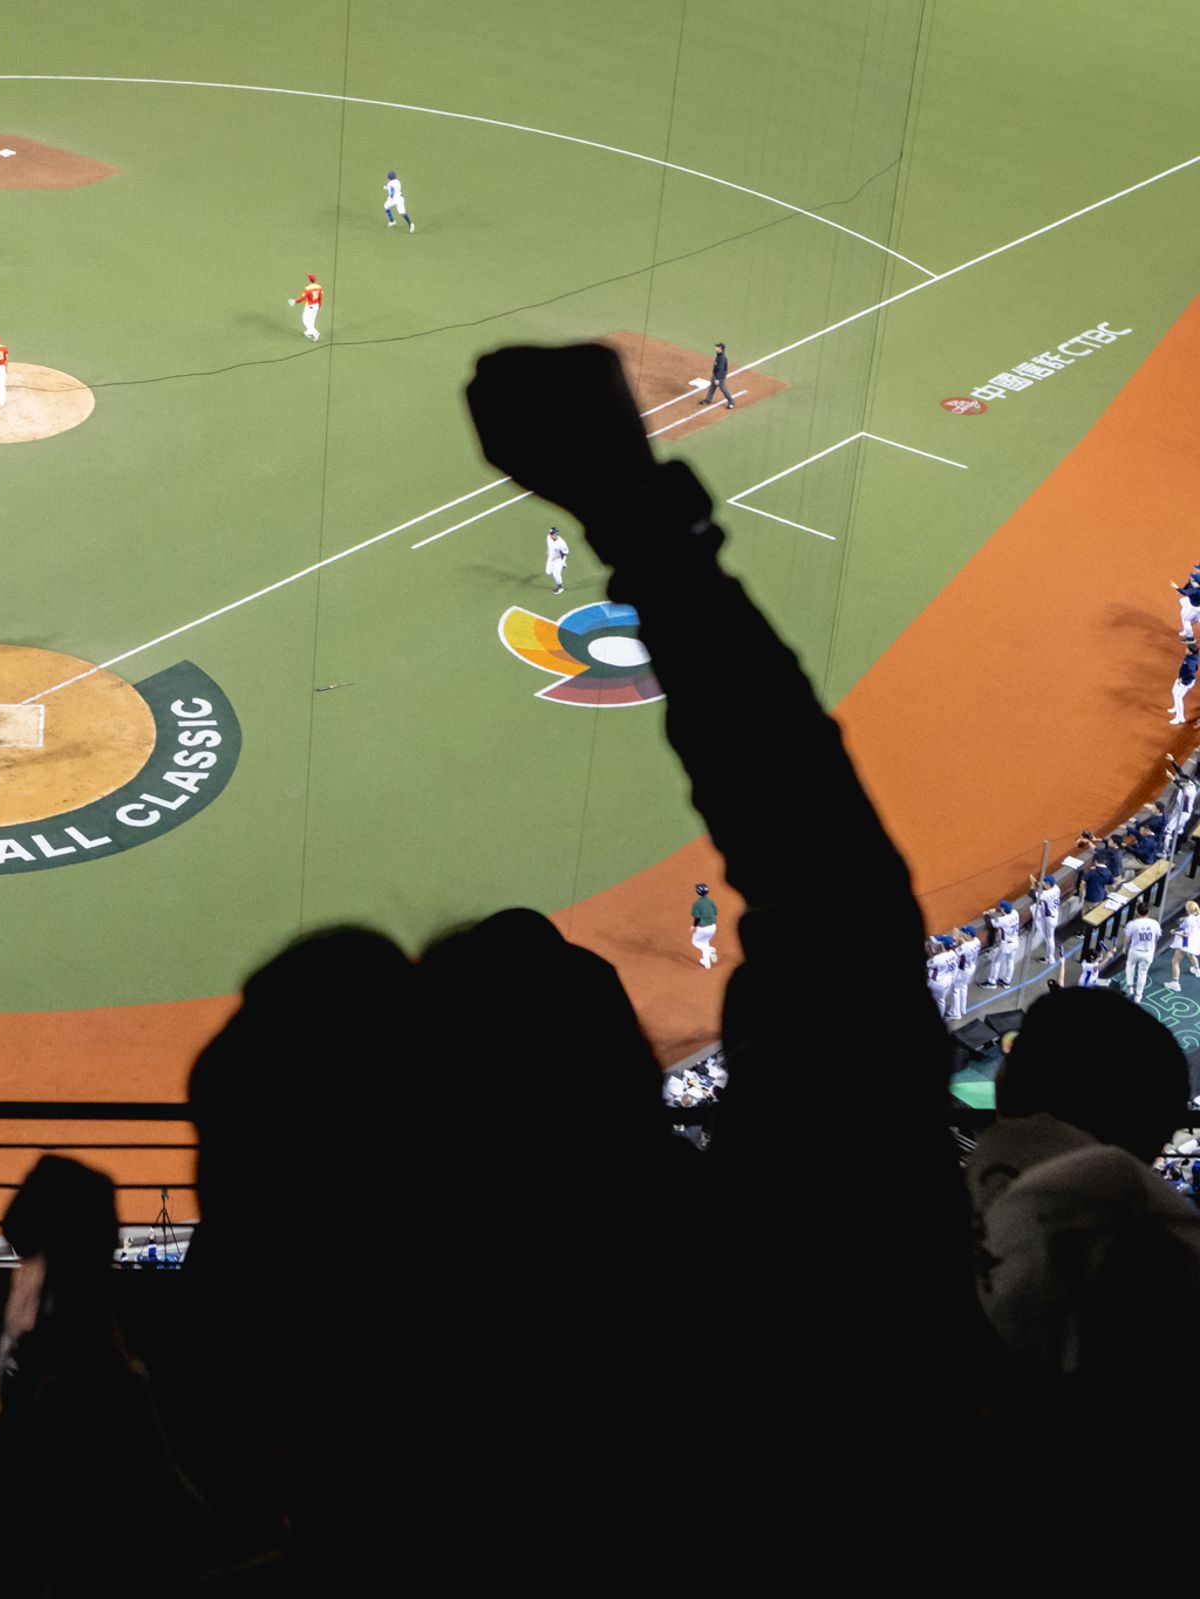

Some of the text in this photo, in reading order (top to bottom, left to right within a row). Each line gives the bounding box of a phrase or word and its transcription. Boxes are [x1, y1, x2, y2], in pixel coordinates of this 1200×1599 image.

[1057, 321, 1133, 357] CTBC
[115, 696, 222, 828] CLASSIC
[1139, 932, 1153, 942] 100
